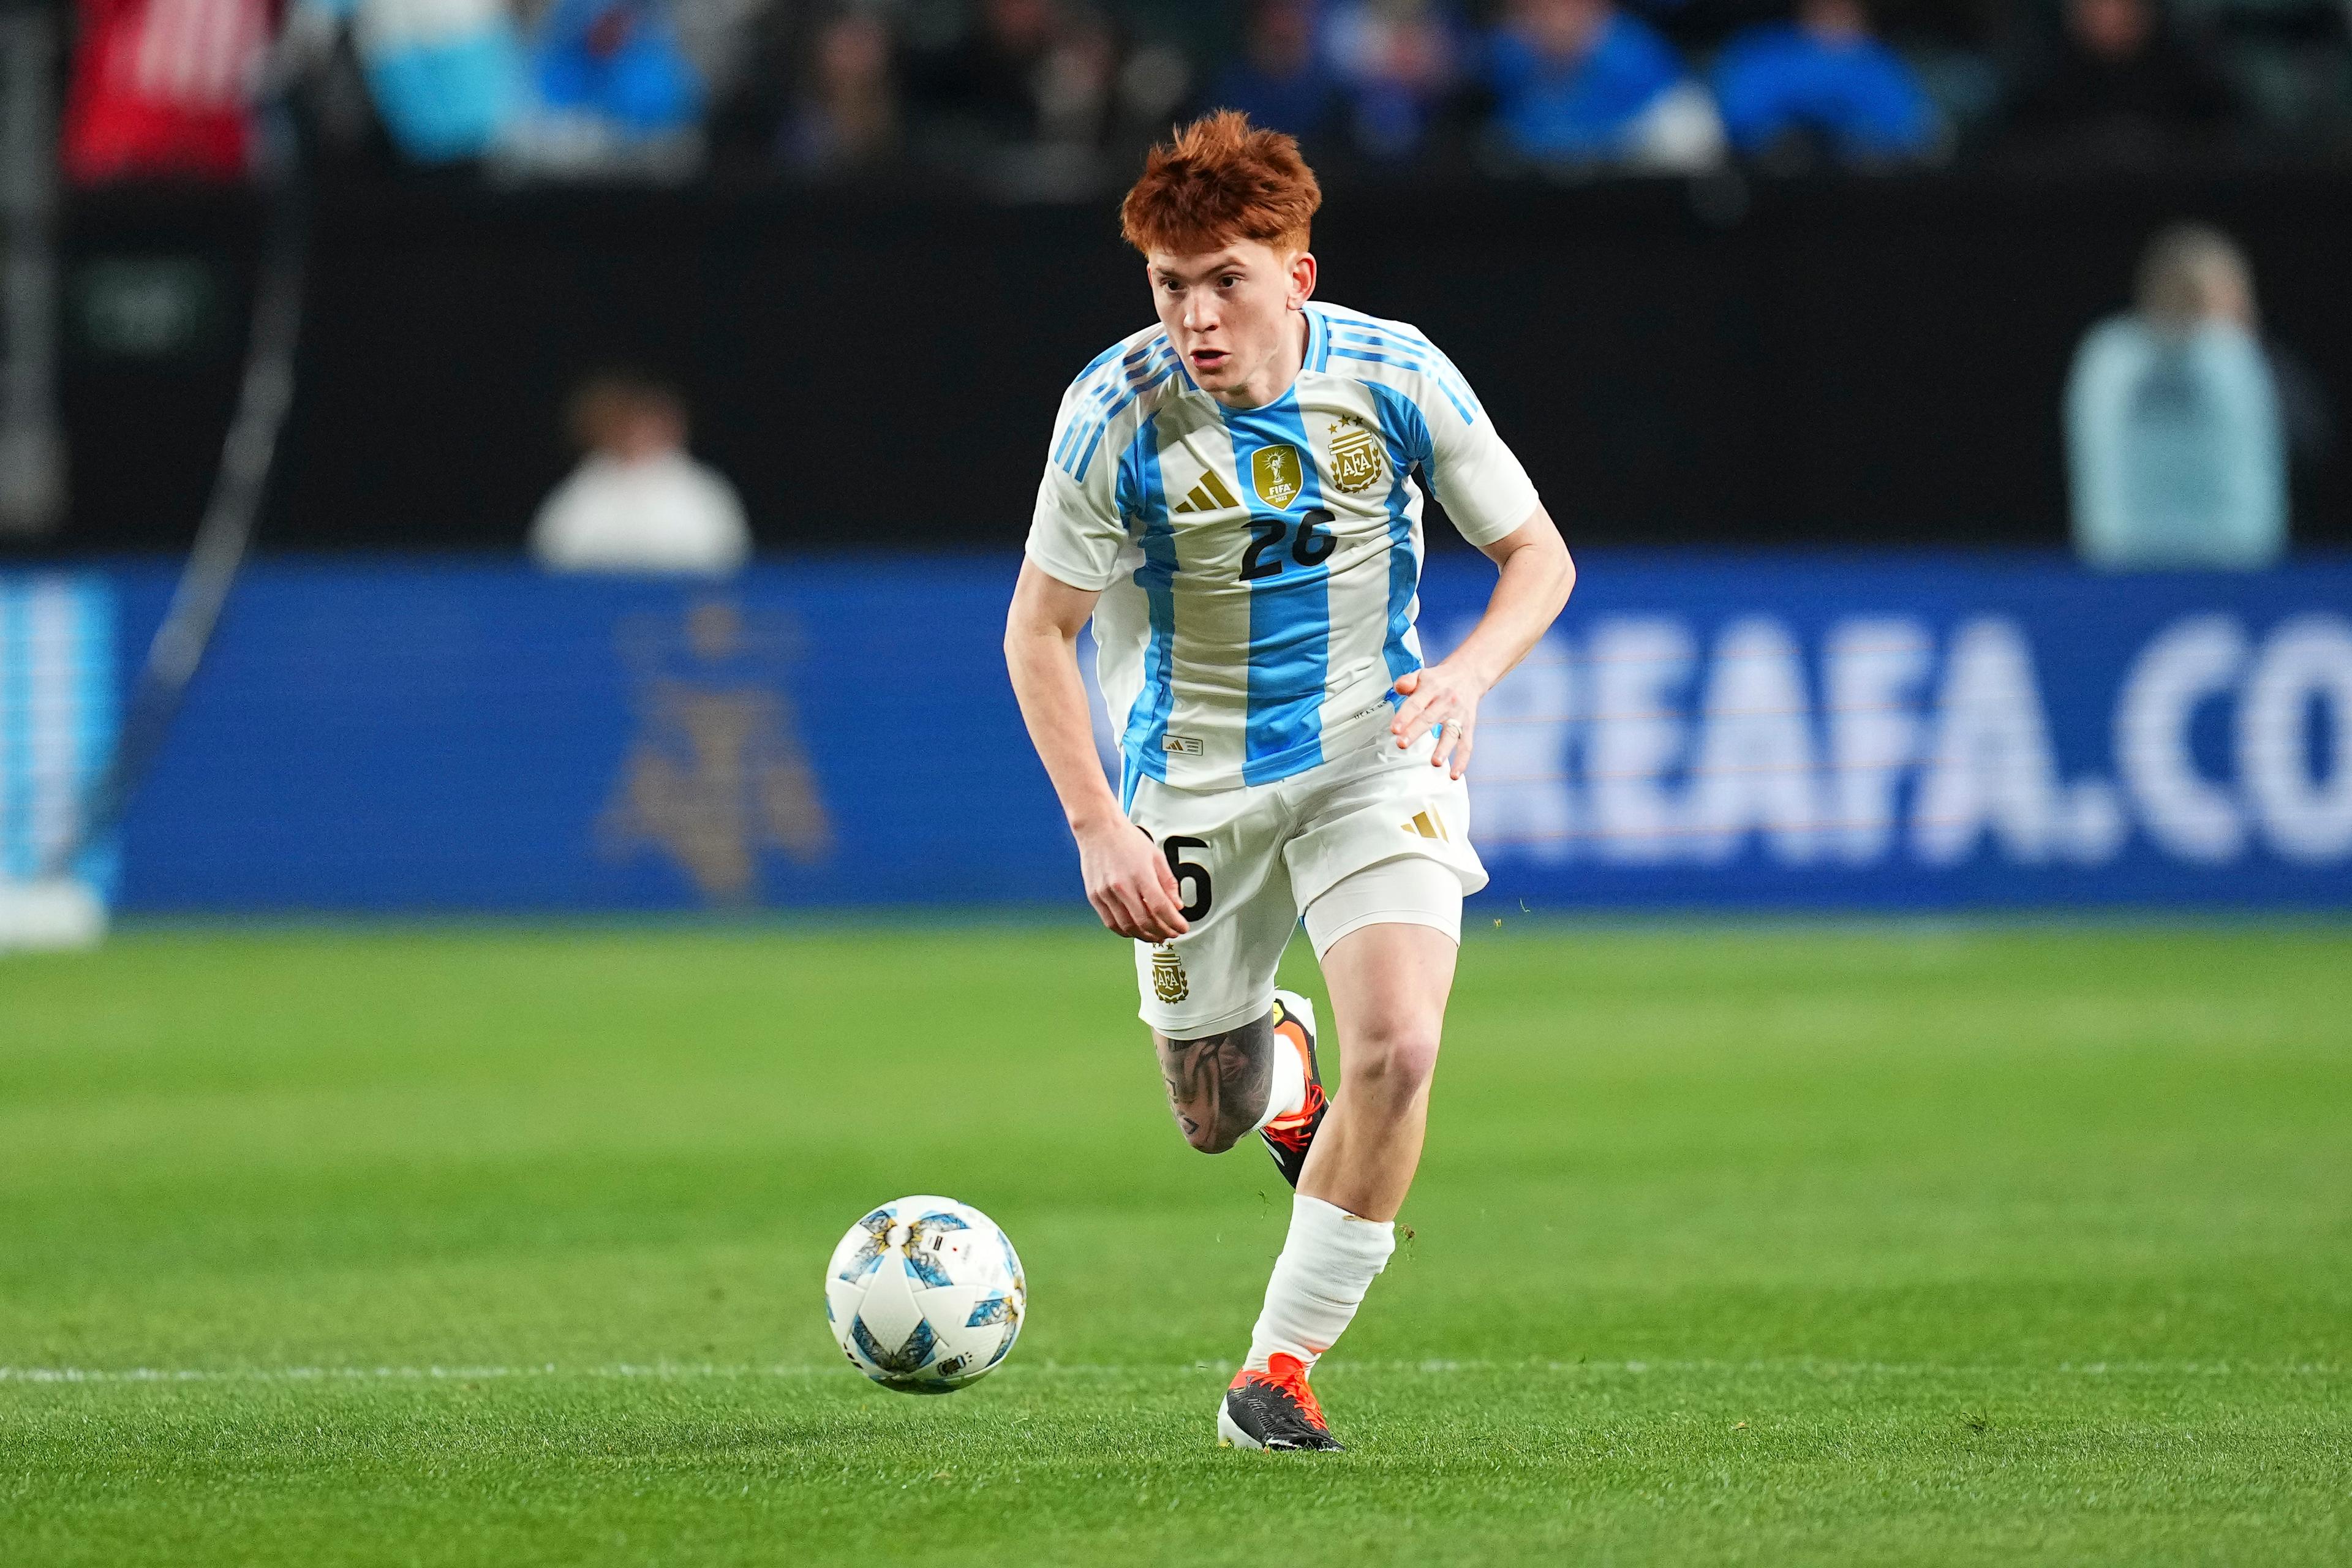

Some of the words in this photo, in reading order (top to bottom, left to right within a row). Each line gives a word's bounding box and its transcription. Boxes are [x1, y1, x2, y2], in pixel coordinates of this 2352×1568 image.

[1343, 448, 1372, 477] AFA
[1268, 483, 1291, 496] FIFA
[1239, 509, 1338, 581] 26
[1135, 825, 1212, 922] 6
[1157, 966, 1180, 990] AFA
